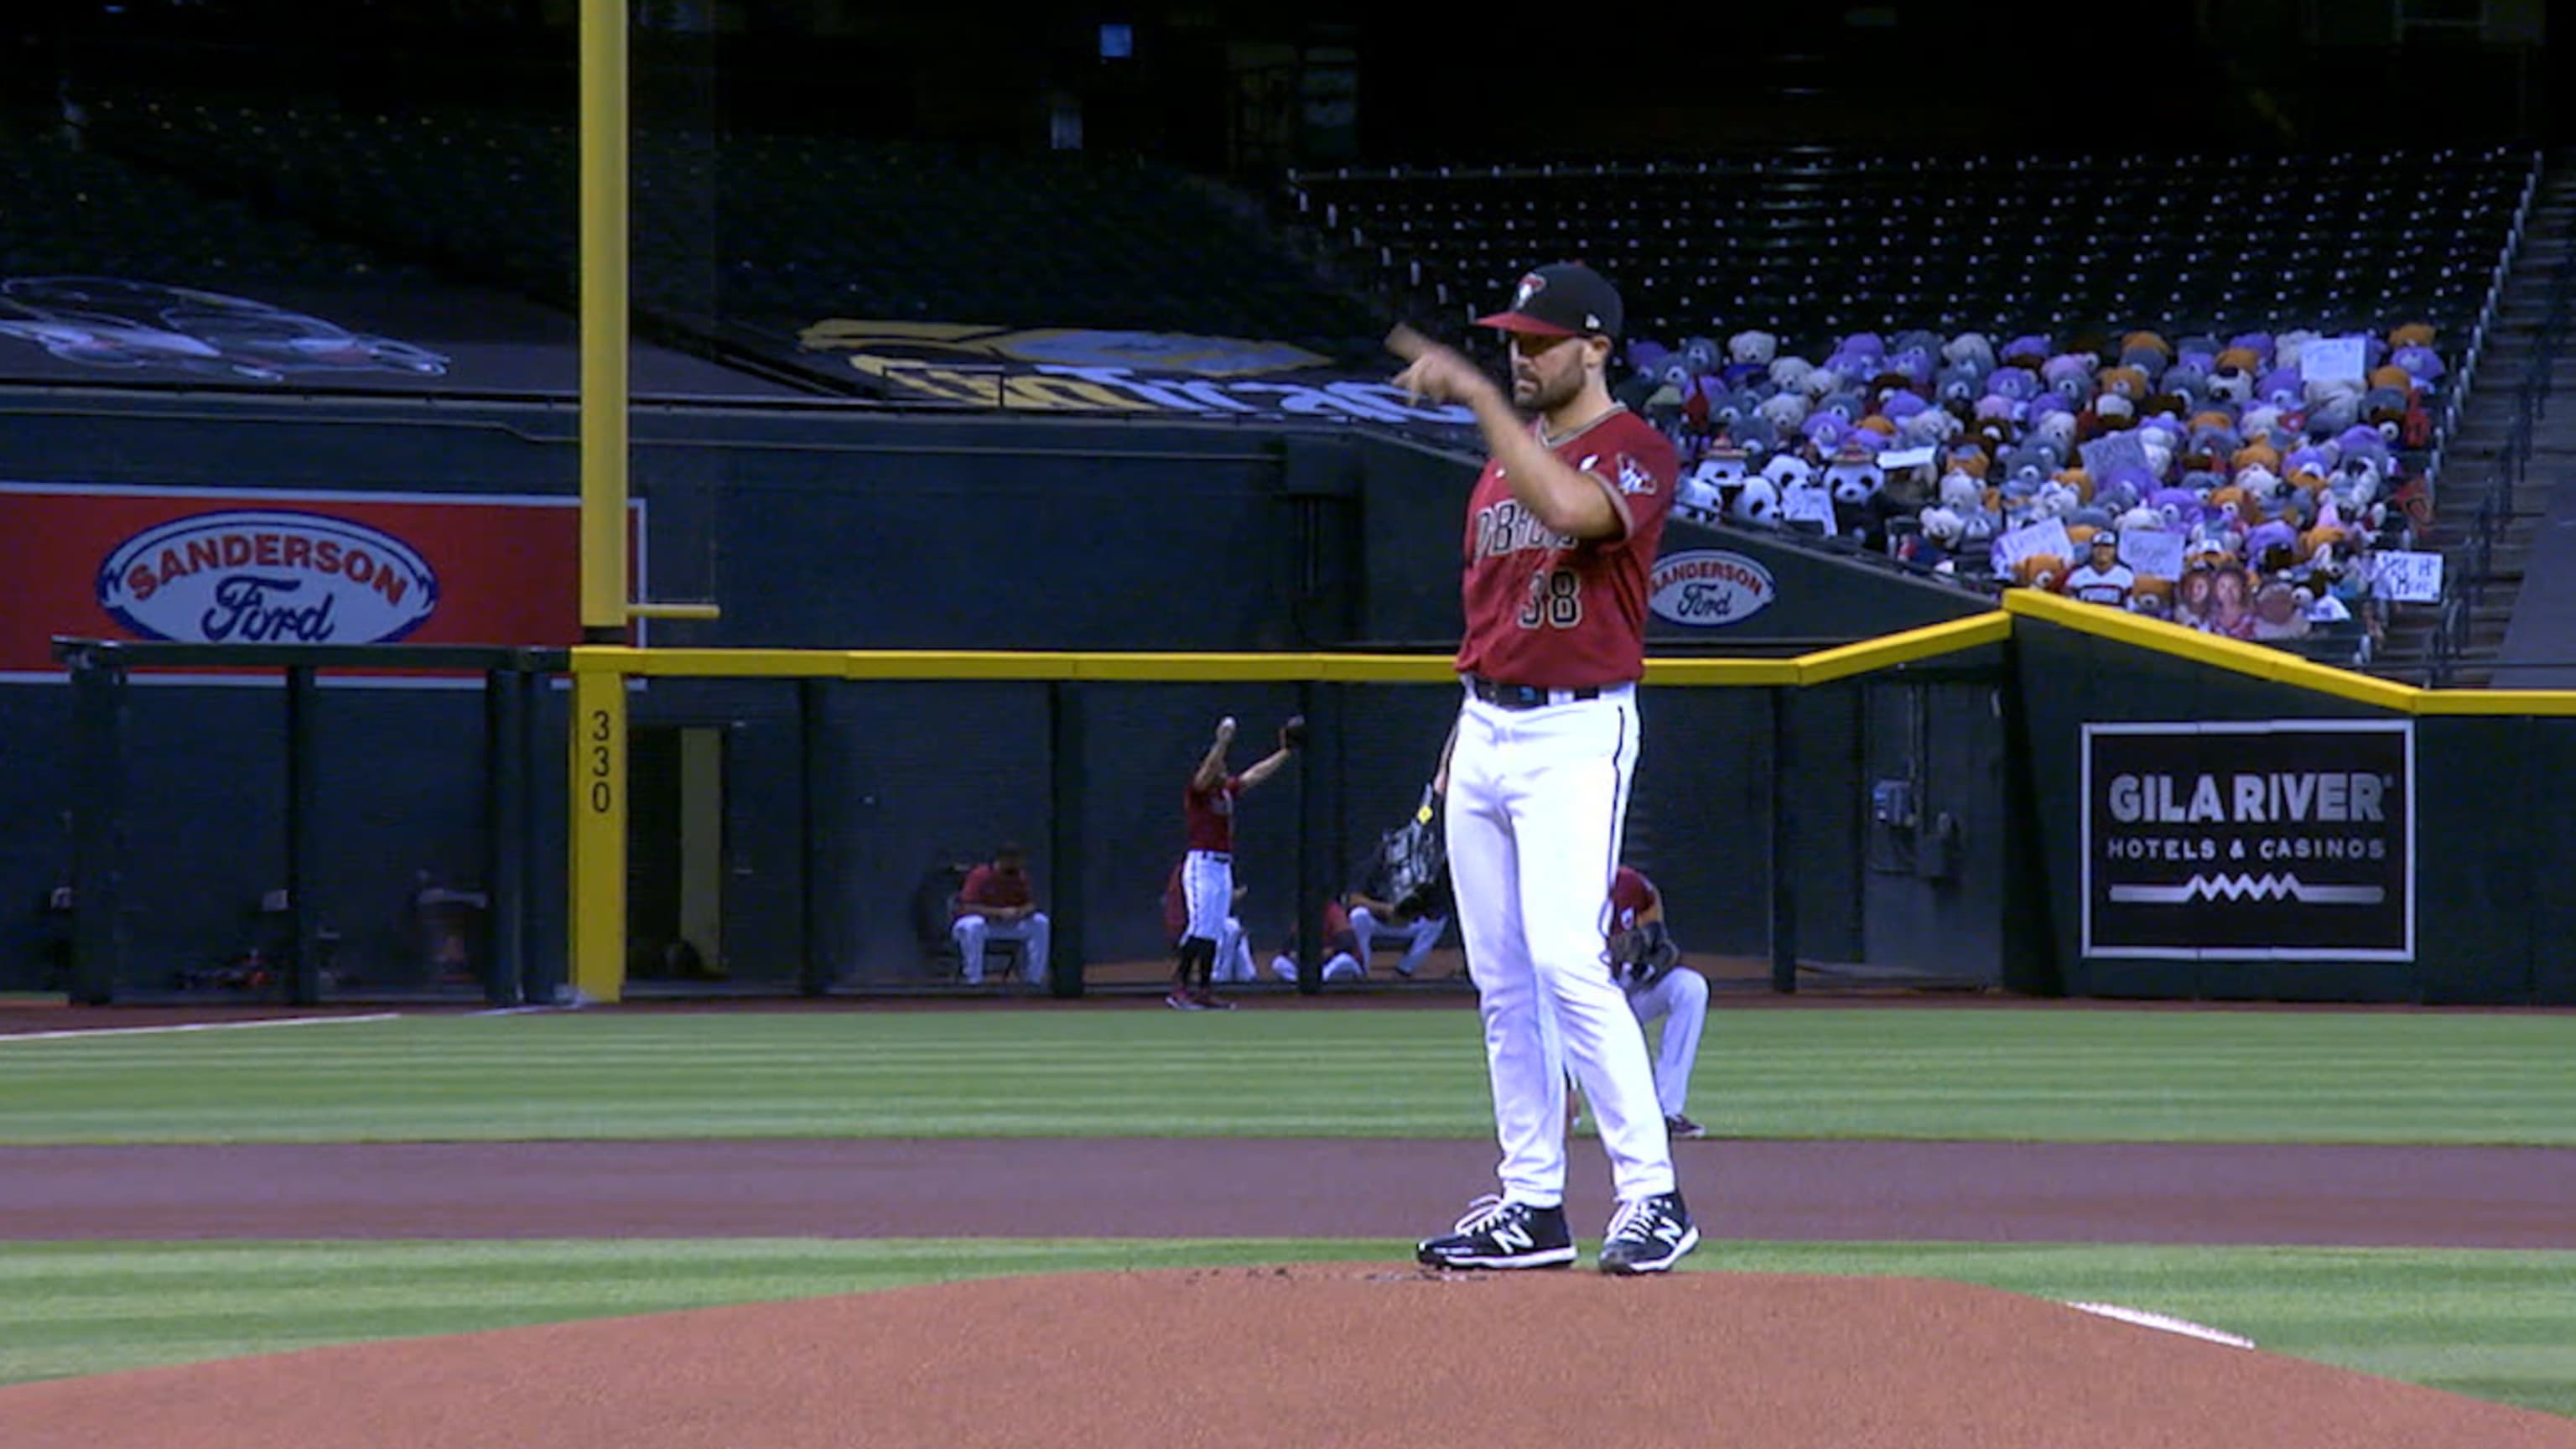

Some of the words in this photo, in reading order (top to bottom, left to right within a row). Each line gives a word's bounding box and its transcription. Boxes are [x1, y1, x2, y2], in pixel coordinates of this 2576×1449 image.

[127, 532, 409, 607] SANDERSON
[1515, 566, 1582, 630] 38
[1676, 583, 1732, 617] Ford
[201, 574, 335, 641] Ford
[592, 709, 610, 813] 330
[2108, 772, 2226, 823] GILA
[2233, 772, 2386, 823] RIVER
[2108, 839, 2216, 860] HOTELS
[2229, 839, 2246, 859] &
[2259, 839, 2386, 860] CASINOS
